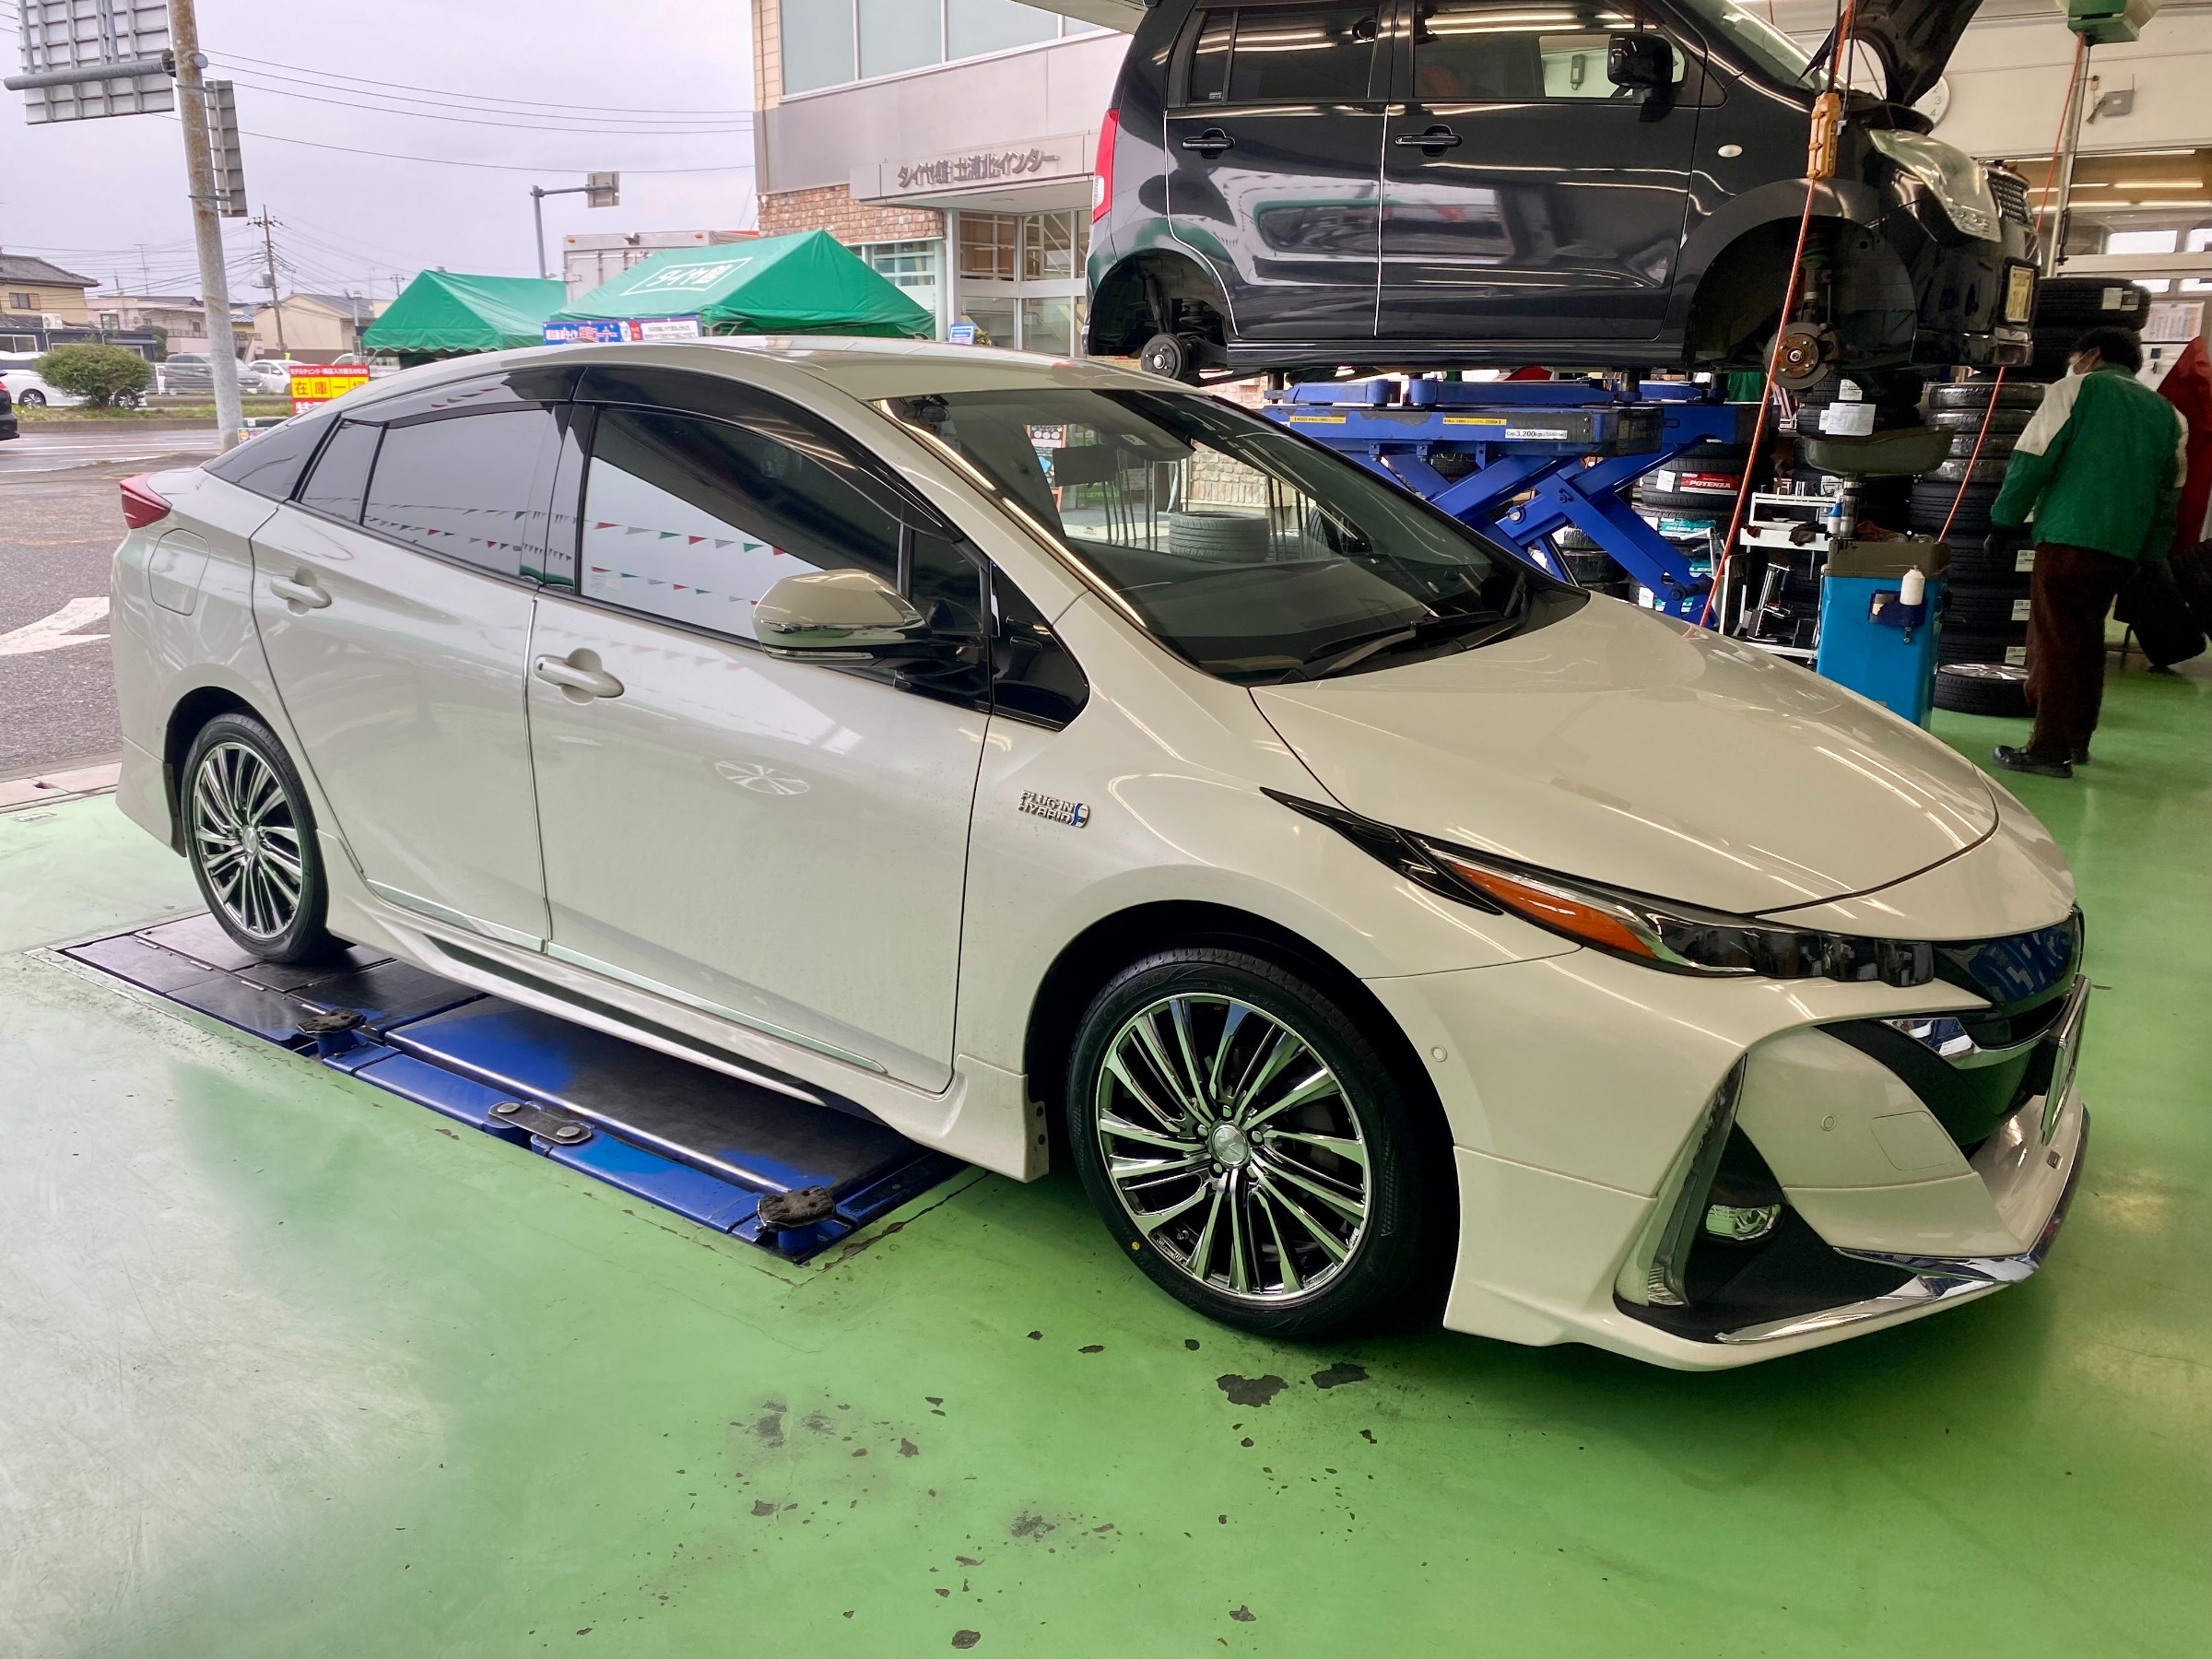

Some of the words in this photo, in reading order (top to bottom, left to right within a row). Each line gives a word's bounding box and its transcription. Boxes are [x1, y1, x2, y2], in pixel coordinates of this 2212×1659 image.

[645, 264, 734, 288] タイヤ館
[1689, 480, 1731, 488] POTENZA
[1018, 799, 1074, 825] HYBRID
